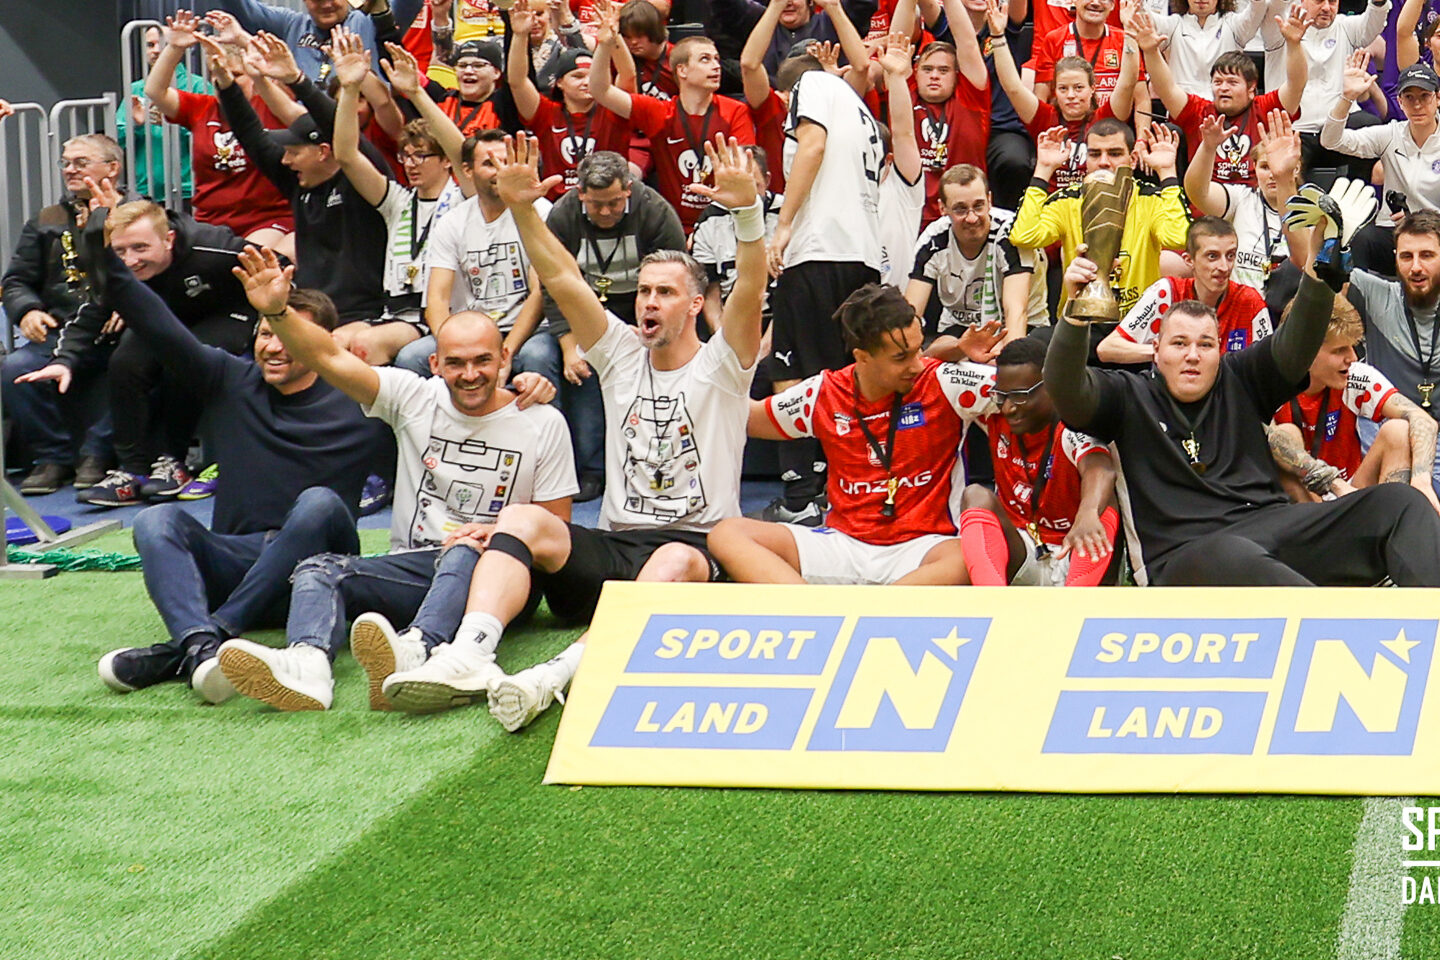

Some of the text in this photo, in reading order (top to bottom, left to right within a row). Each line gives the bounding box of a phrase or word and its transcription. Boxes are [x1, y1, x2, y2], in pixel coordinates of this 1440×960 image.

[946, 367, 985, 381] Schuller
[898, 470, 932, 489] AG
[1039, 516, 1071, 530] AG
[656, 628, 816, 660] SPORT
[1097, 632, 1259, 664] SPORT
[834, 637, 945, 731] N
[1294, 640, 1406, 733] N
[635, 702, 769, 734] LAND
[1088, 706, 1224, 739] LAND
